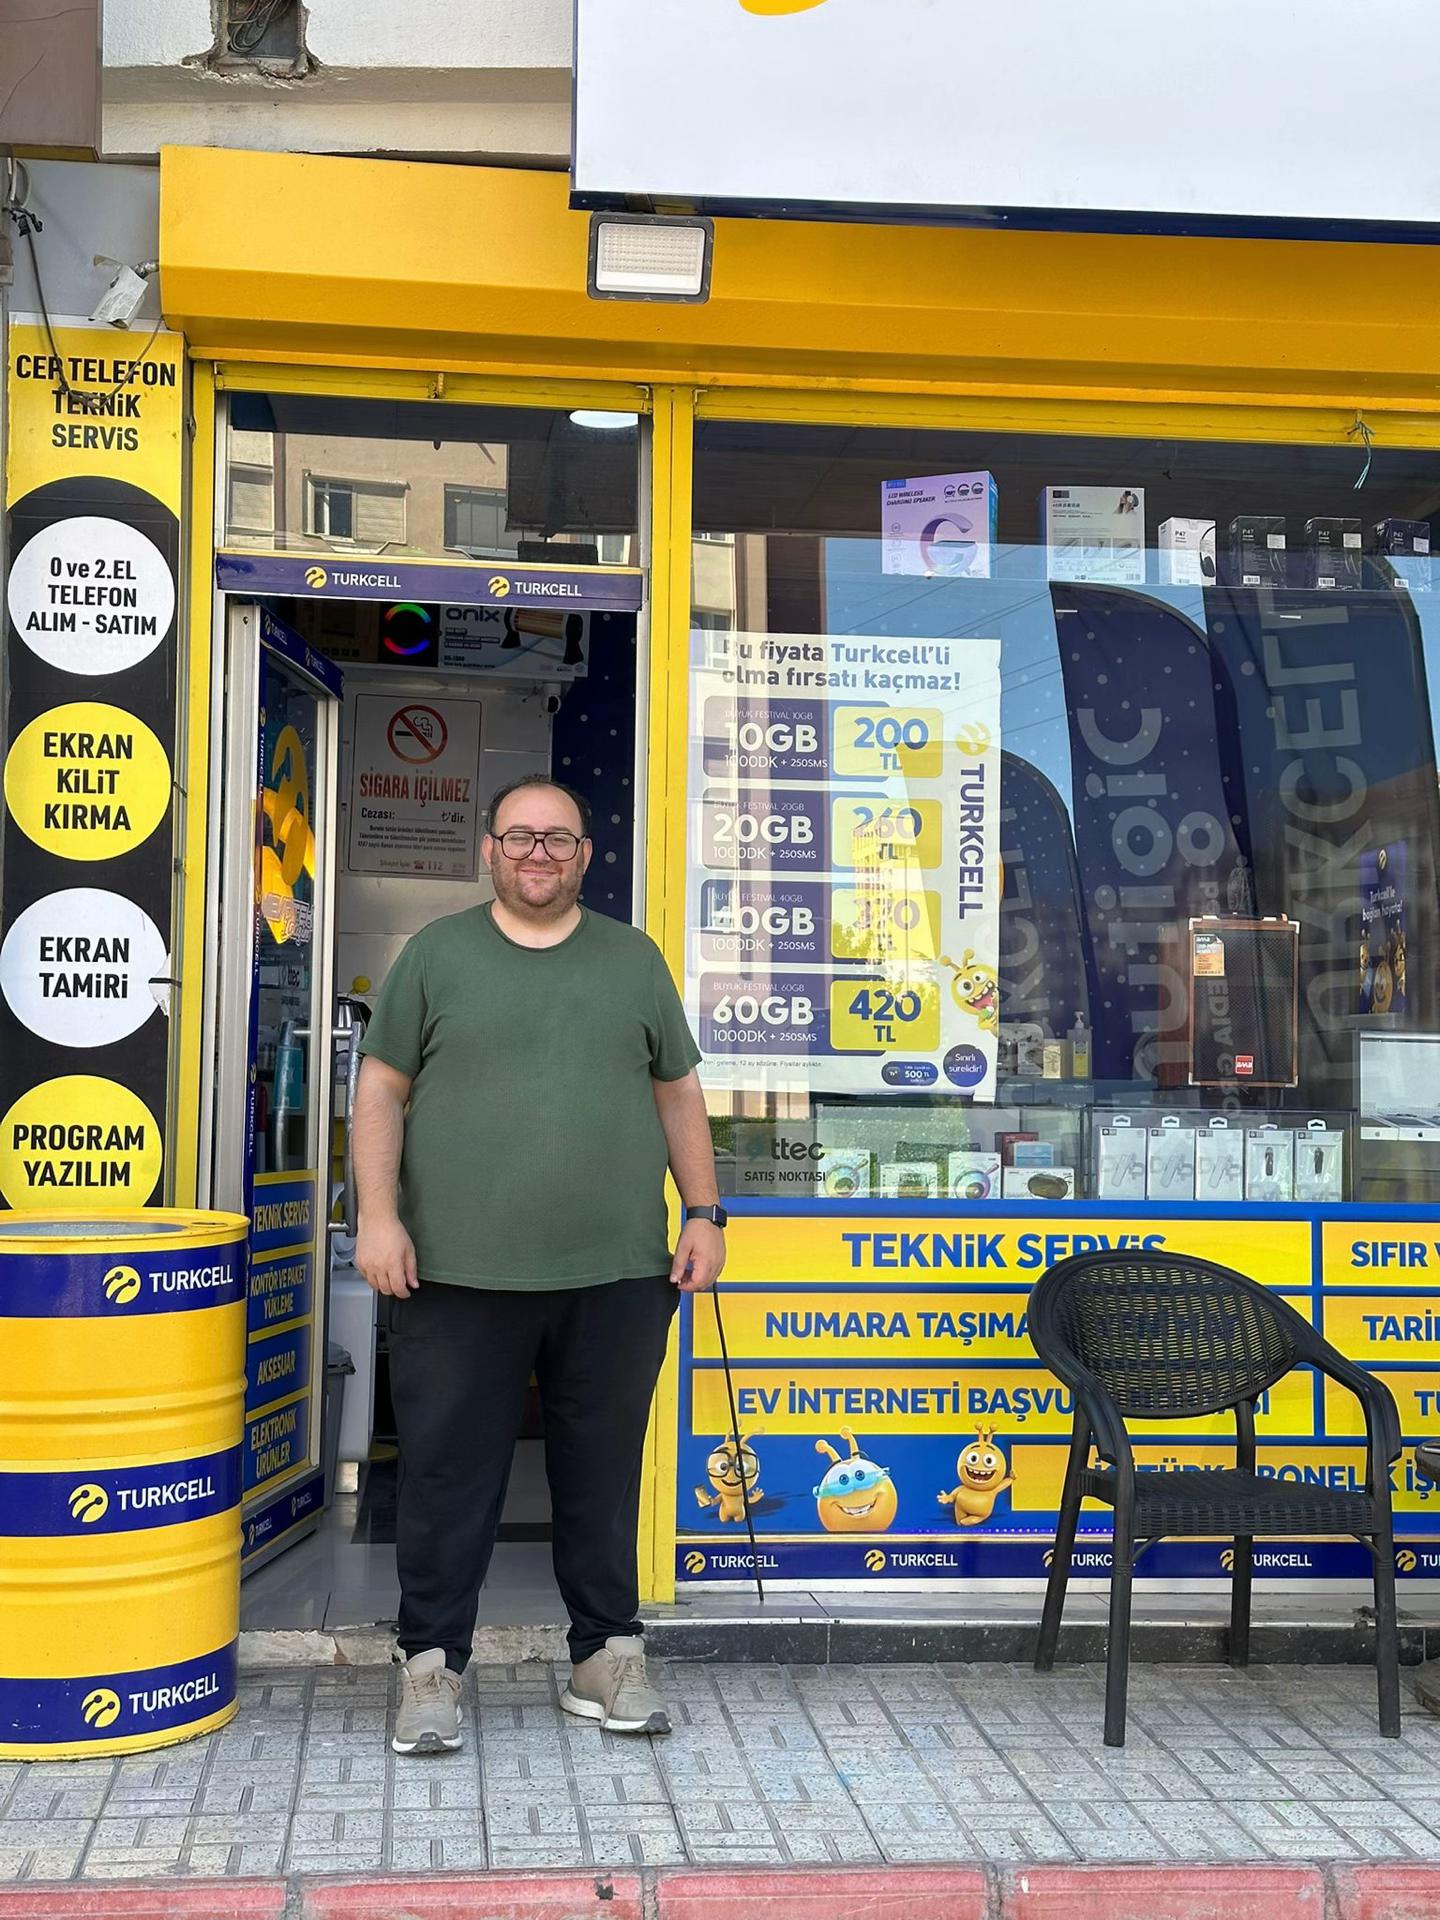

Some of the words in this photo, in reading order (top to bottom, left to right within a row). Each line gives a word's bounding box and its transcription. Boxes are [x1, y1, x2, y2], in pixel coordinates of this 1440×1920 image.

[16, 355, 63, 380] CEP
[68, 358, 176, 386] TELEFON
[50, 557, 62, 577] 0
[67, 561, 90, 578] ve
[94, 559, 137, 580] 2.EL
[332, 572, 401, 589] TURKCELL
[48, 584, 137, 606] TELEFON
[515, 582, 582, 597] TURKCELL
[26, 611, 76, 632] ALIM
[95, 614, 157, 636] SATIM
[446, 606, 500, 623] onix
[760, 641, 824, 664] fiyata
[831, 643, 950, 665] Turkcell'li
[722, 665, 780, 685] olma
[787, 667, 857, 688] fırsatı
[864, 670, 960, 693] kaçmaz!
[43, 732, 133, 760] EKRAN
[723, 722, 818, 753] 10GB
[854, 717, 929, 750] 200
[790, 758, 828, 769] 250SMS
[880, 752, 903, 770] TL
[359, 766, 409, 800] SİGARA
[414, 769, 471, 808] İÇİLMEZ
[44, 804, 132, 831] KIRMA
[361, 807, 395, 821] Cezası:
[852, 806, 923, 839] 260
[713, 813, 814, 844] 20GB
[960, 763, 985, 920] TURKCELL
[713, 846, 767, 860] 1000DK
[779, 849, 817, 860] 250SMS
[716, 906, 815, 935] 0GB
[39, 936, 130, 963] EKRAN
[712, 938, 764, 951] 1000DK
[778, 940, 816, 951] 250SMS
[712, 994, 814, 1025] 60GB
[849, 989, 922, 1022] 420
[713, 1029, 767, 1042] 1000DK
[779, 1032, 817, 1042] 250SMS
[874, 1025, 896, 1042] TL
[905, 1070, 923, 1078] 500
[12, 1124, 145, 1152] PROGRAM
[771, 1138, 825, 1160] ttec
[23, 1161, 131, 1188] YAZILIM
[745, 1171, 775, 1184] SATIŞ
[779, 1171, 826, 1182] NOKTASI
[1351, 1241, 1428, 1267] SIFIR
[149, 1263, 234, 1294] TURKCELL
[766, 1312, 910, 1338] NUMARA
[1362, 1309, 1440, 1341] TARİ
[257, 1349, 296, 1386] AKSESUAR
[738, 1388, 781, 1413] EV
[789, 1381, 959, 1414] İNTERNETİ
[968, 1388, 1075, 1421] BAŞVU
[117, 1475, 216, 1510] TURKCELL
[1406, 1459, 1440, 1500] İŞ
[710, 1555, 778, 1568] TURKCELL
[891, 1553, 958, 1566] TURKCELL
[1070, 1554, 1135, 1567] TURKC
[129, 1672, 220, 1715] TURKCELL
